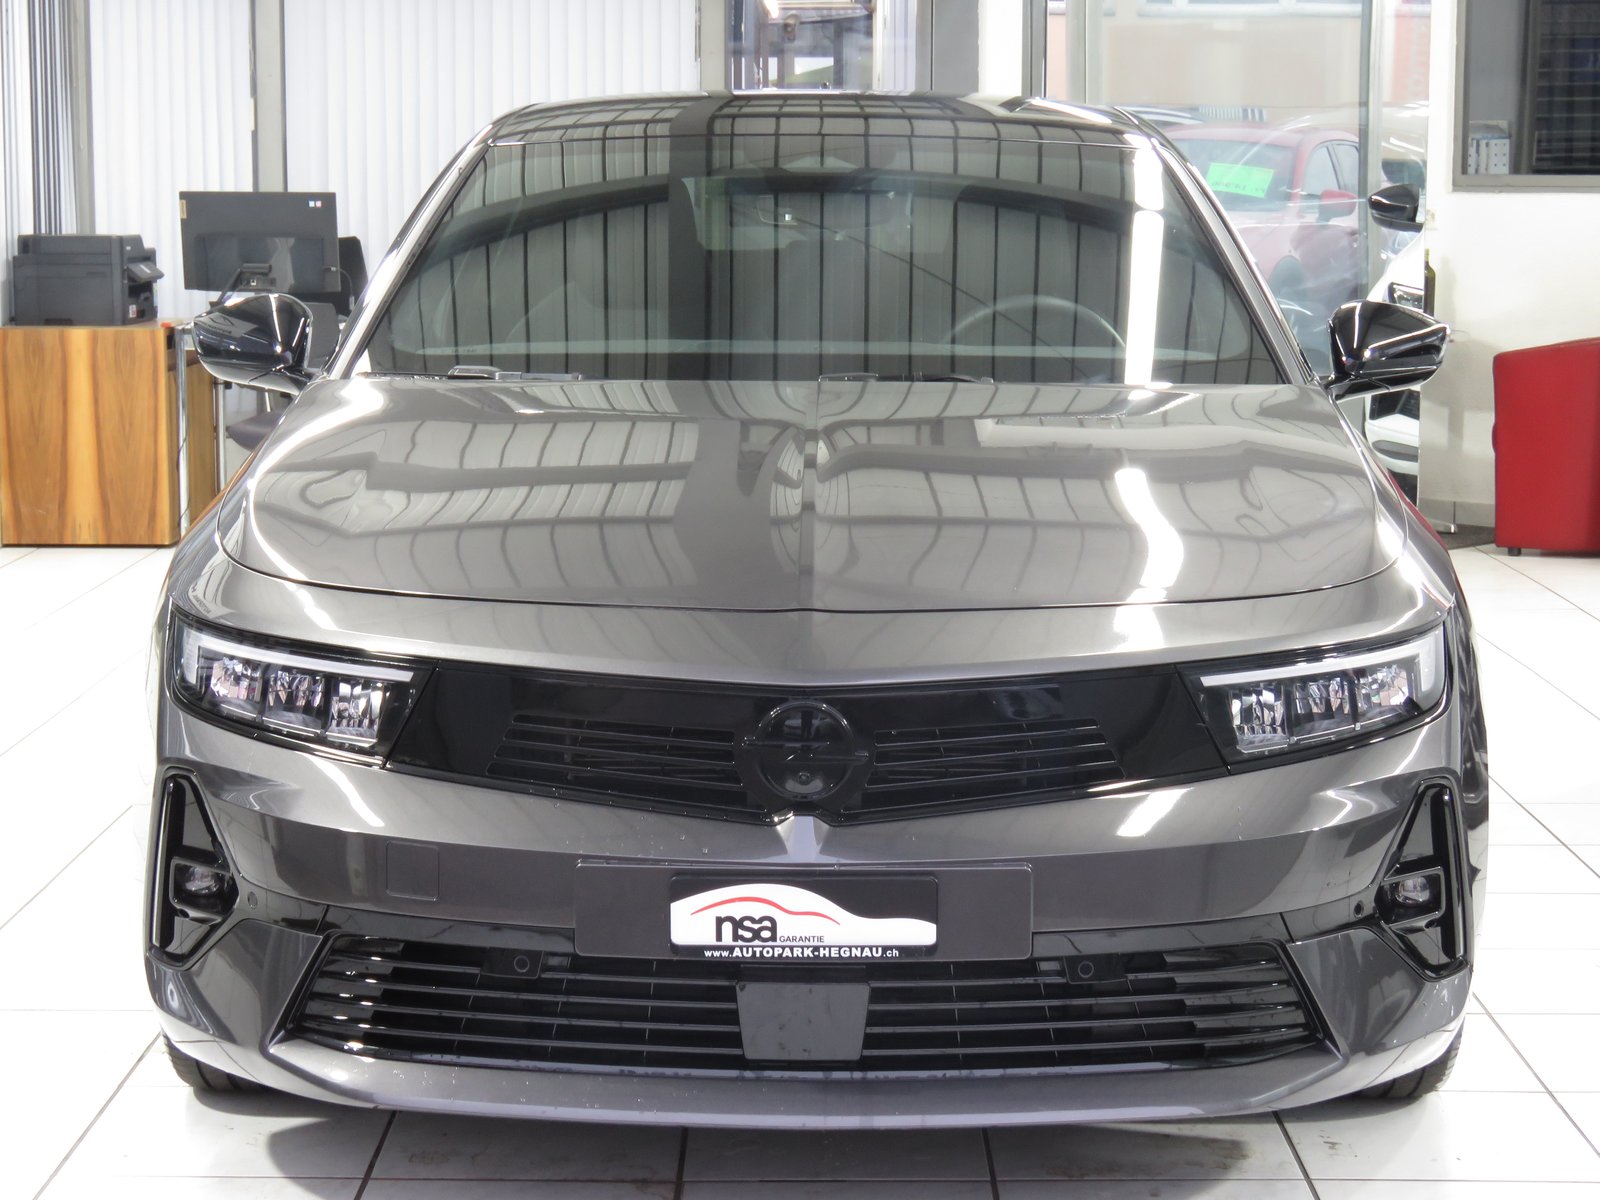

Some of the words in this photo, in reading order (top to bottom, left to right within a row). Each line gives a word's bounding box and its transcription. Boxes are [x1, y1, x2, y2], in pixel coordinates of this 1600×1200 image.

[715, 915, 778, 943] nsa
[779, 935, 825, 943] GARANTIE
[703, 947, 899, 958] www.AUTOPARK-HEGNAU.ch
